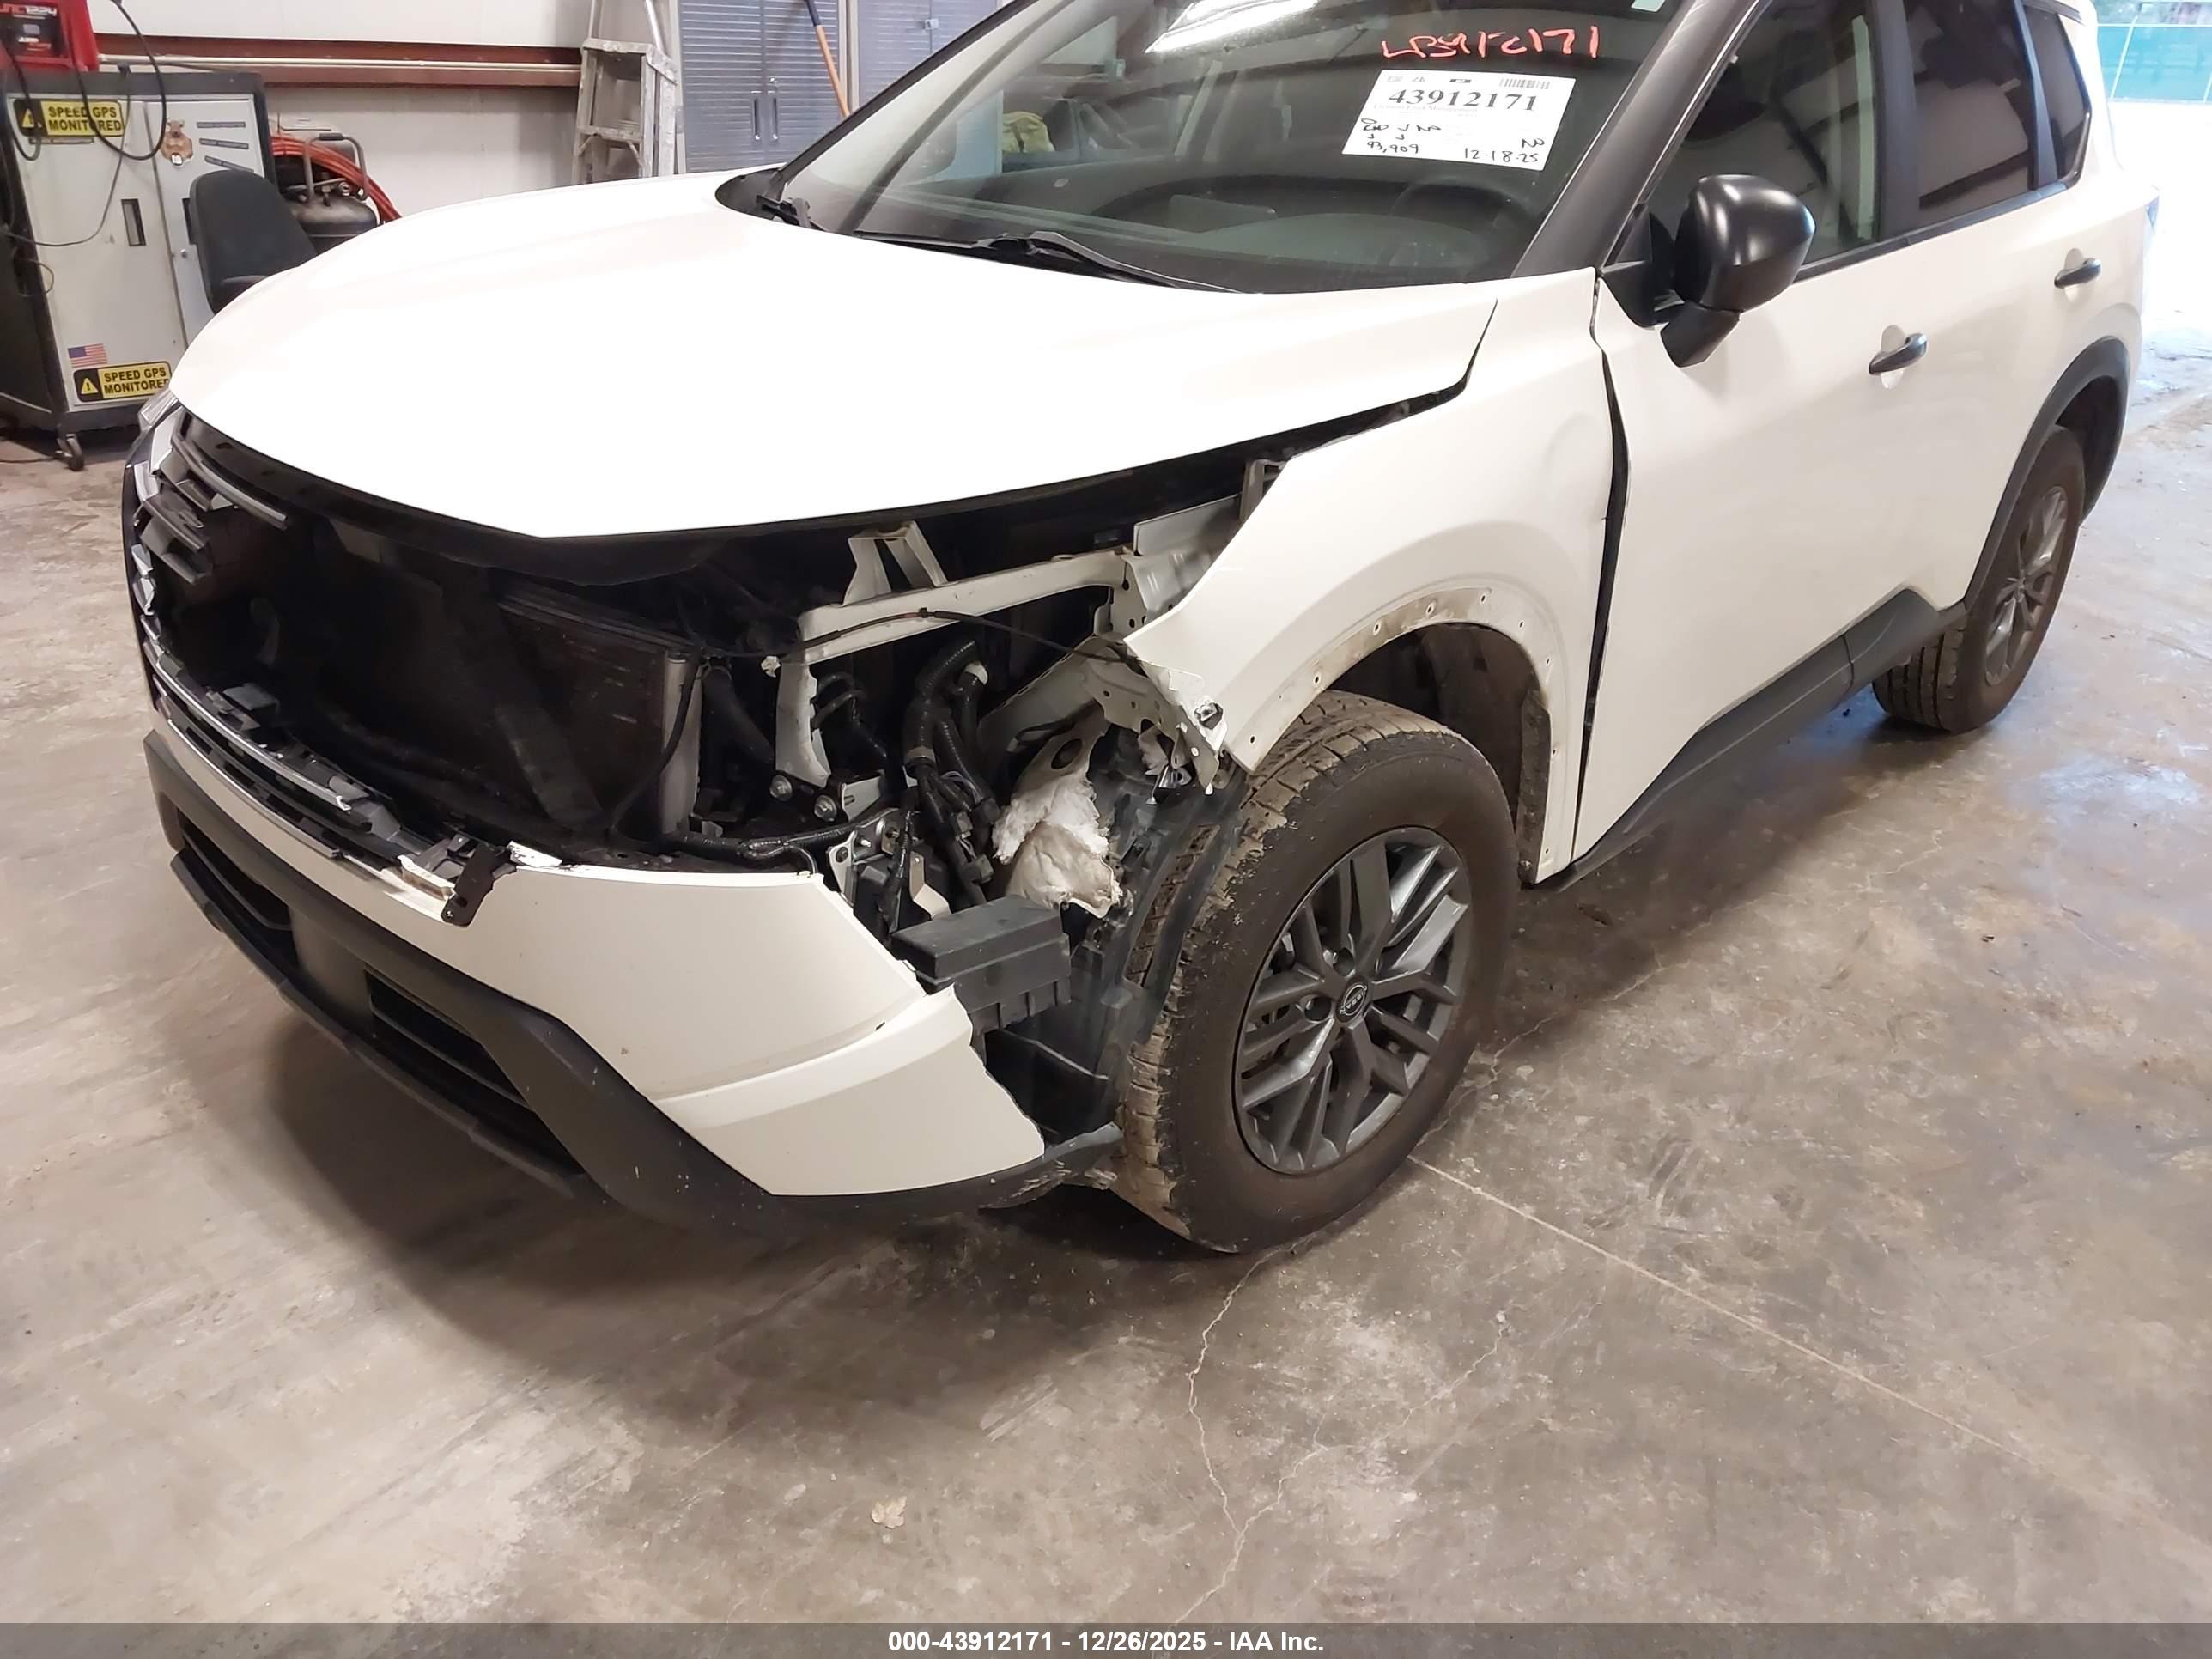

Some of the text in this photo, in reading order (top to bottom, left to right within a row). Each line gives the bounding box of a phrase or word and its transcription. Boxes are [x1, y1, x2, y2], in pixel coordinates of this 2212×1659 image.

[1388, 88, 1538, 112] 43912171
[48, 106, 117, 118] SPEED GPS
[49, 119, 121, 131] MONITRED
[104, 367, 167, 383] SPEED GPS
